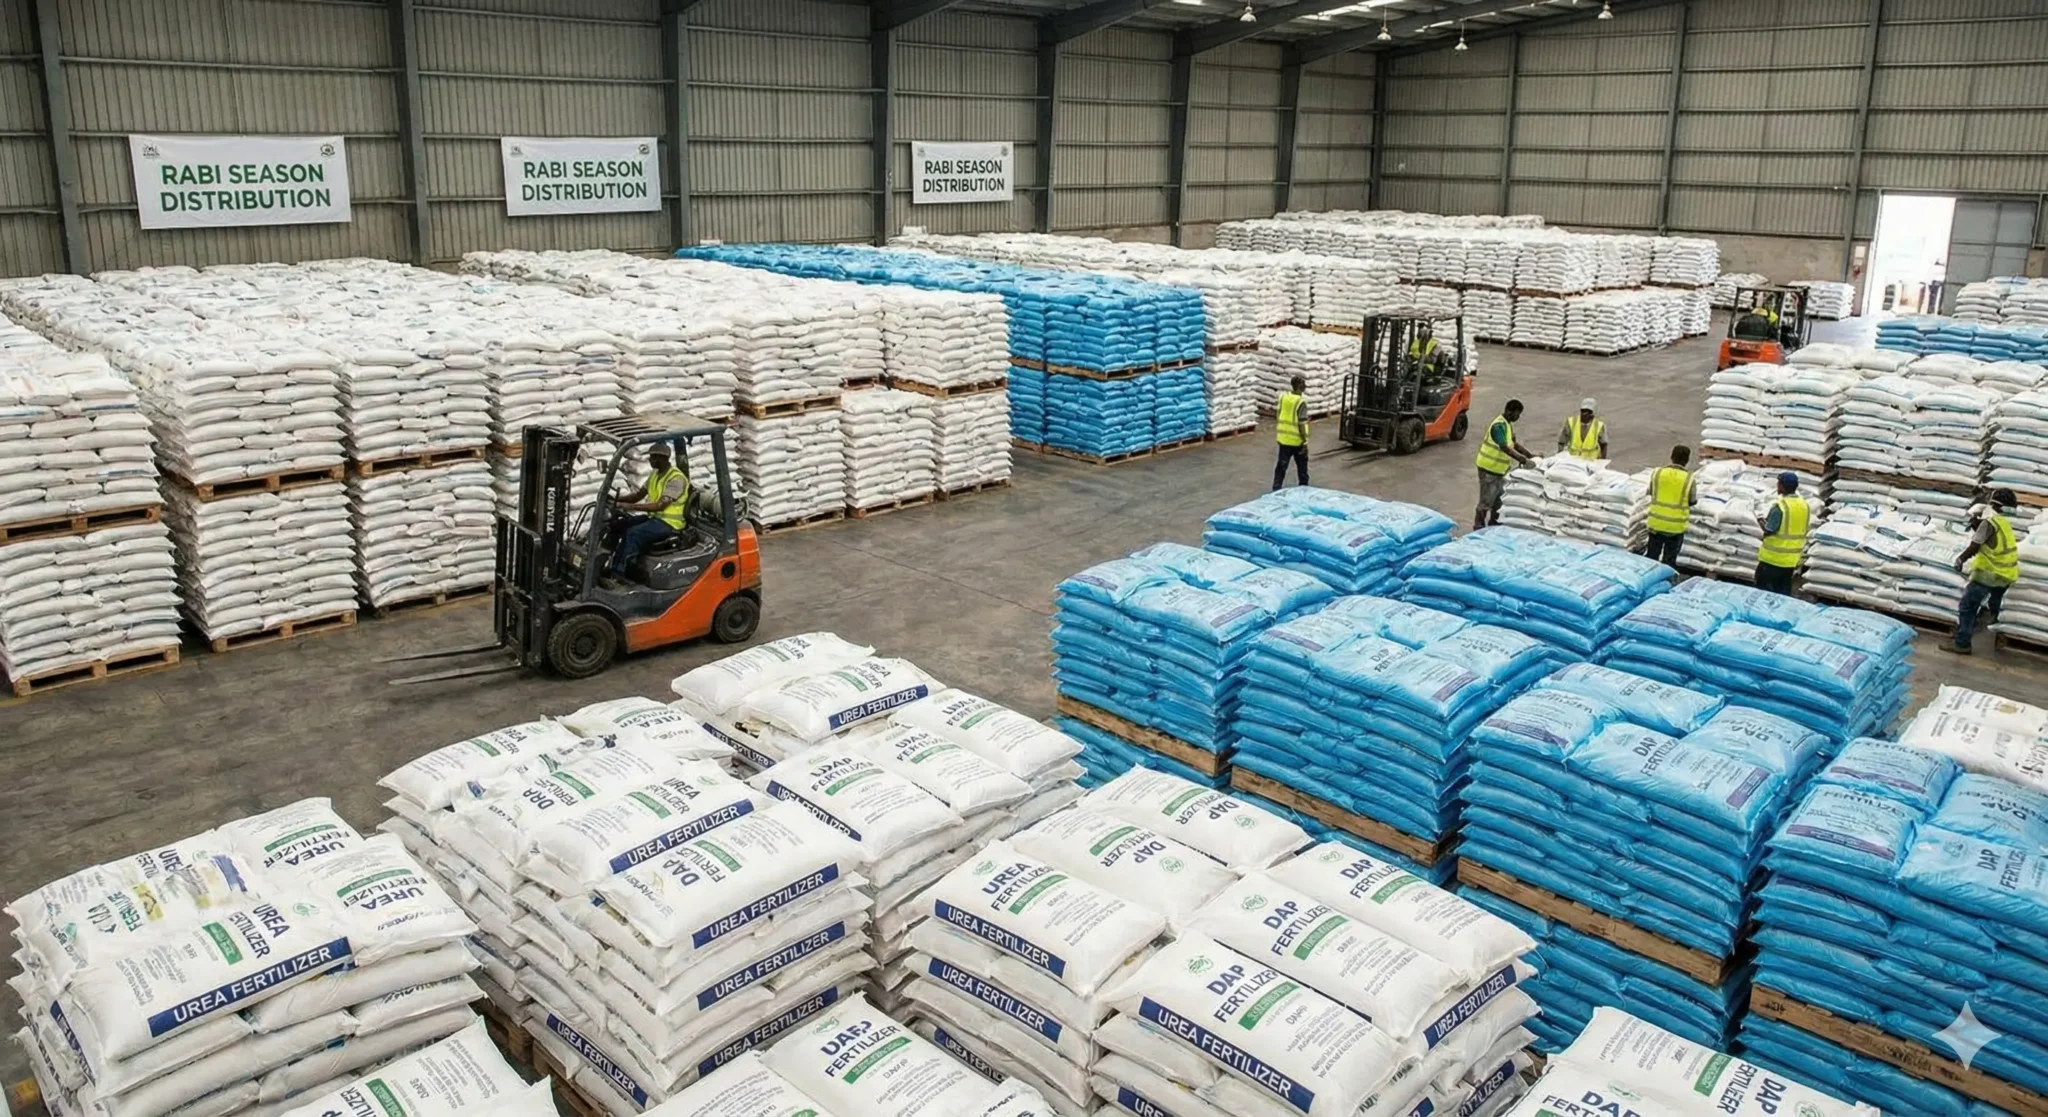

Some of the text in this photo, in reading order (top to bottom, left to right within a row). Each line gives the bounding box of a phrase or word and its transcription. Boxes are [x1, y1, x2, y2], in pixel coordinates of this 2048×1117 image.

[162, 163, 324, 185] RABI SEASON
[524, 160, 643, 178] RABI SEASON
[924, 160, 1002, 174] RABI SEASON
[160, 188, 332, 212] DISTRIBUTION
[522, 182, 647, 201] DISTRIBUTION
[922, 178, 1004, 193] DISTRIBUTION
[838, 706, 865, 725] UREA
[867, 688, 918, 716] FERTILIZER
[1209, 800, 1240, 820] DAP
[263, 830, 350, 868] FERTILIZER
[626, 806, 740, 865] UREA FERTILIZER
[1134, 840, 1166, 864] DAP
[284, 841, 346, 866] UREA
[1340, 858, 1374, 880] DAP
[982, 862, 1032, 896] UREA
[360, 886, 425, 910] UREA
[709, 873, 824, 938] UREA FERTILIZER
[1262, 900, 1300, 930] DAP
[252, 903, 291, 938] UREA
[947, 906, 1050, 969] UREA FERTILIZER
[714, 932, 830, 998] UREA FERTILIZER
[1206, 964, 1246, 996] DAP
[173, 990, 229, 1022] UREA
[230, 946, 332, 998] FERTILIZER
[942, 964, 1045, 1032] UREA FERTILIZER
[1458, 974, 1507, 1021] FERTILIZER
[714, 996, 824, 1066] UREA FERTILIZER
[556, 1021, 636, 1095] UREA FERTILIZER
[824, 1026, 901, 1077] FERTILIZER
[1157, 1008, 1198, 1044] UREA
[1201, 1034, 1292, 1098] FERTILIZER
[1754, 1078, 1788, 1114] DAP
